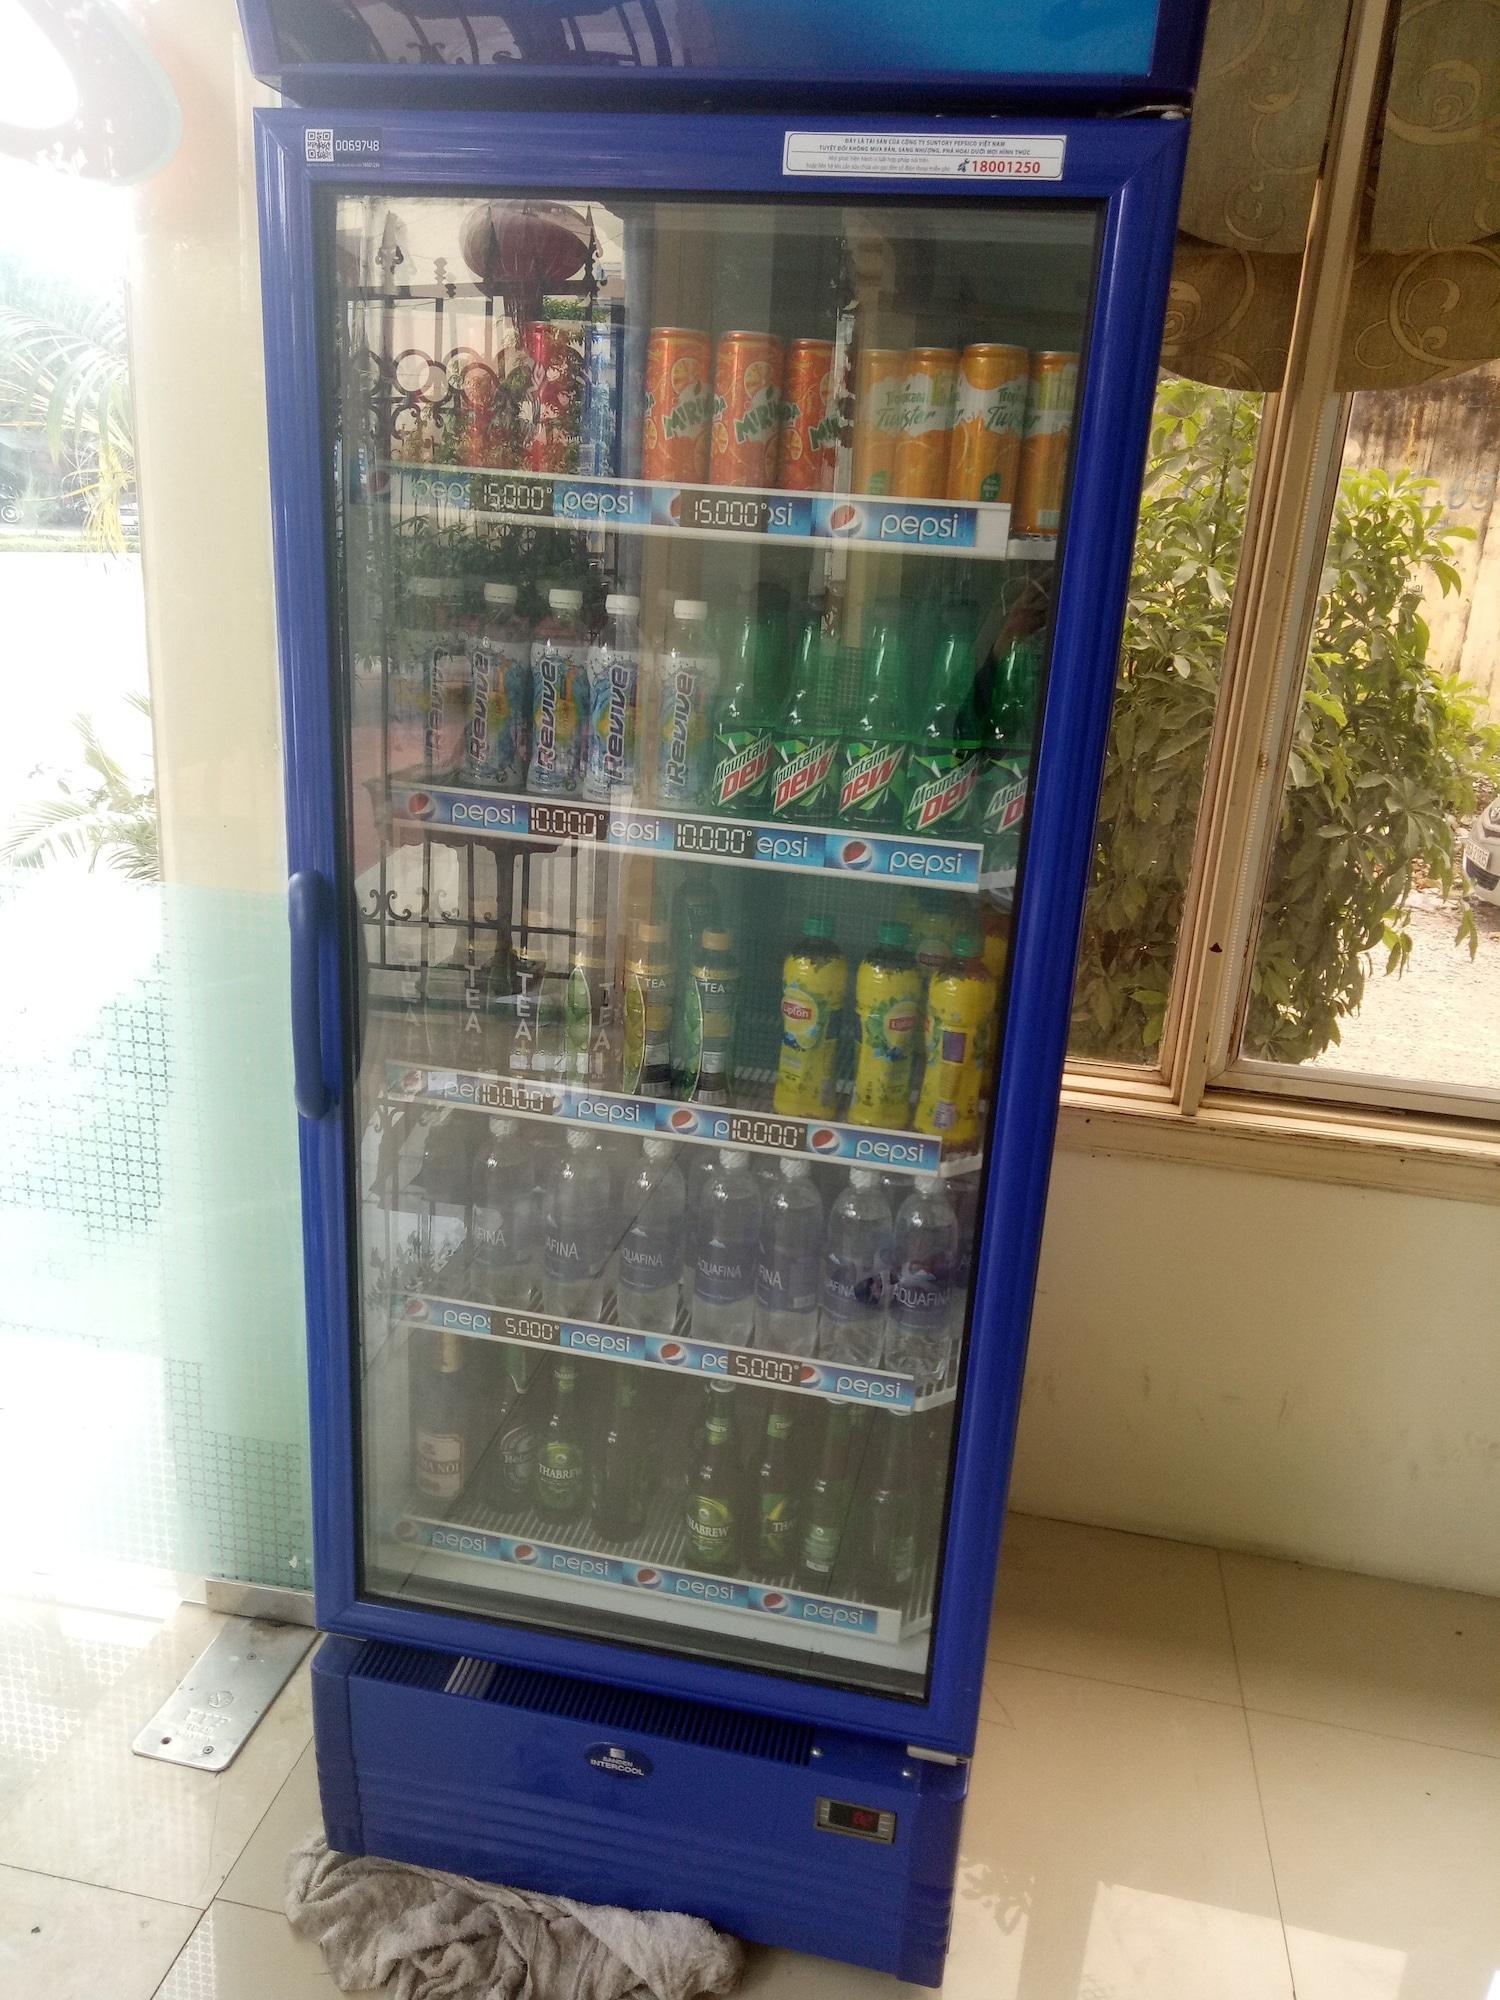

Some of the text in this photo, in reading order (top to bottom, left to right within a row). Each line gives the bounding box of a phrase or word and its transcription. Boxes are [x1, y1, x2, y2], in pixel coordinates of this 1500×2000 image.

[335, 140, 380, 151] 0069748
[972, 160, 1041, 174] 18001250
[412, 474, 470, 508] peps
[563, 489, 634, 517] pepsi
[879, 512, 959, 542] pepsi
[451, 801, 517, 826] pepsi
[610, 819, 661, 841] epsi
[756, 836, 808, 860] epsi
[888, 849, 962, 876] pepsi
[703, 982, 726, 994] TEA
[577, 1098, 640, 1123] pepsi
[855, 1138, 925, 1163] pepsi
[623, 1247, 664, 1267] QUAFINA
[570, 1330, 630, 1353] pepsi
[836, 1374, 901, 1399] pepsi
[431, 1530, 487, 1552] pepsi
[552, 1554, 609, 1576] pepsi
[675, 1577, 735, 1600] pepsi
[802, 1600, 864, 1625] pepsi
[589, 1758, 645, 1776] INTERCOOL
